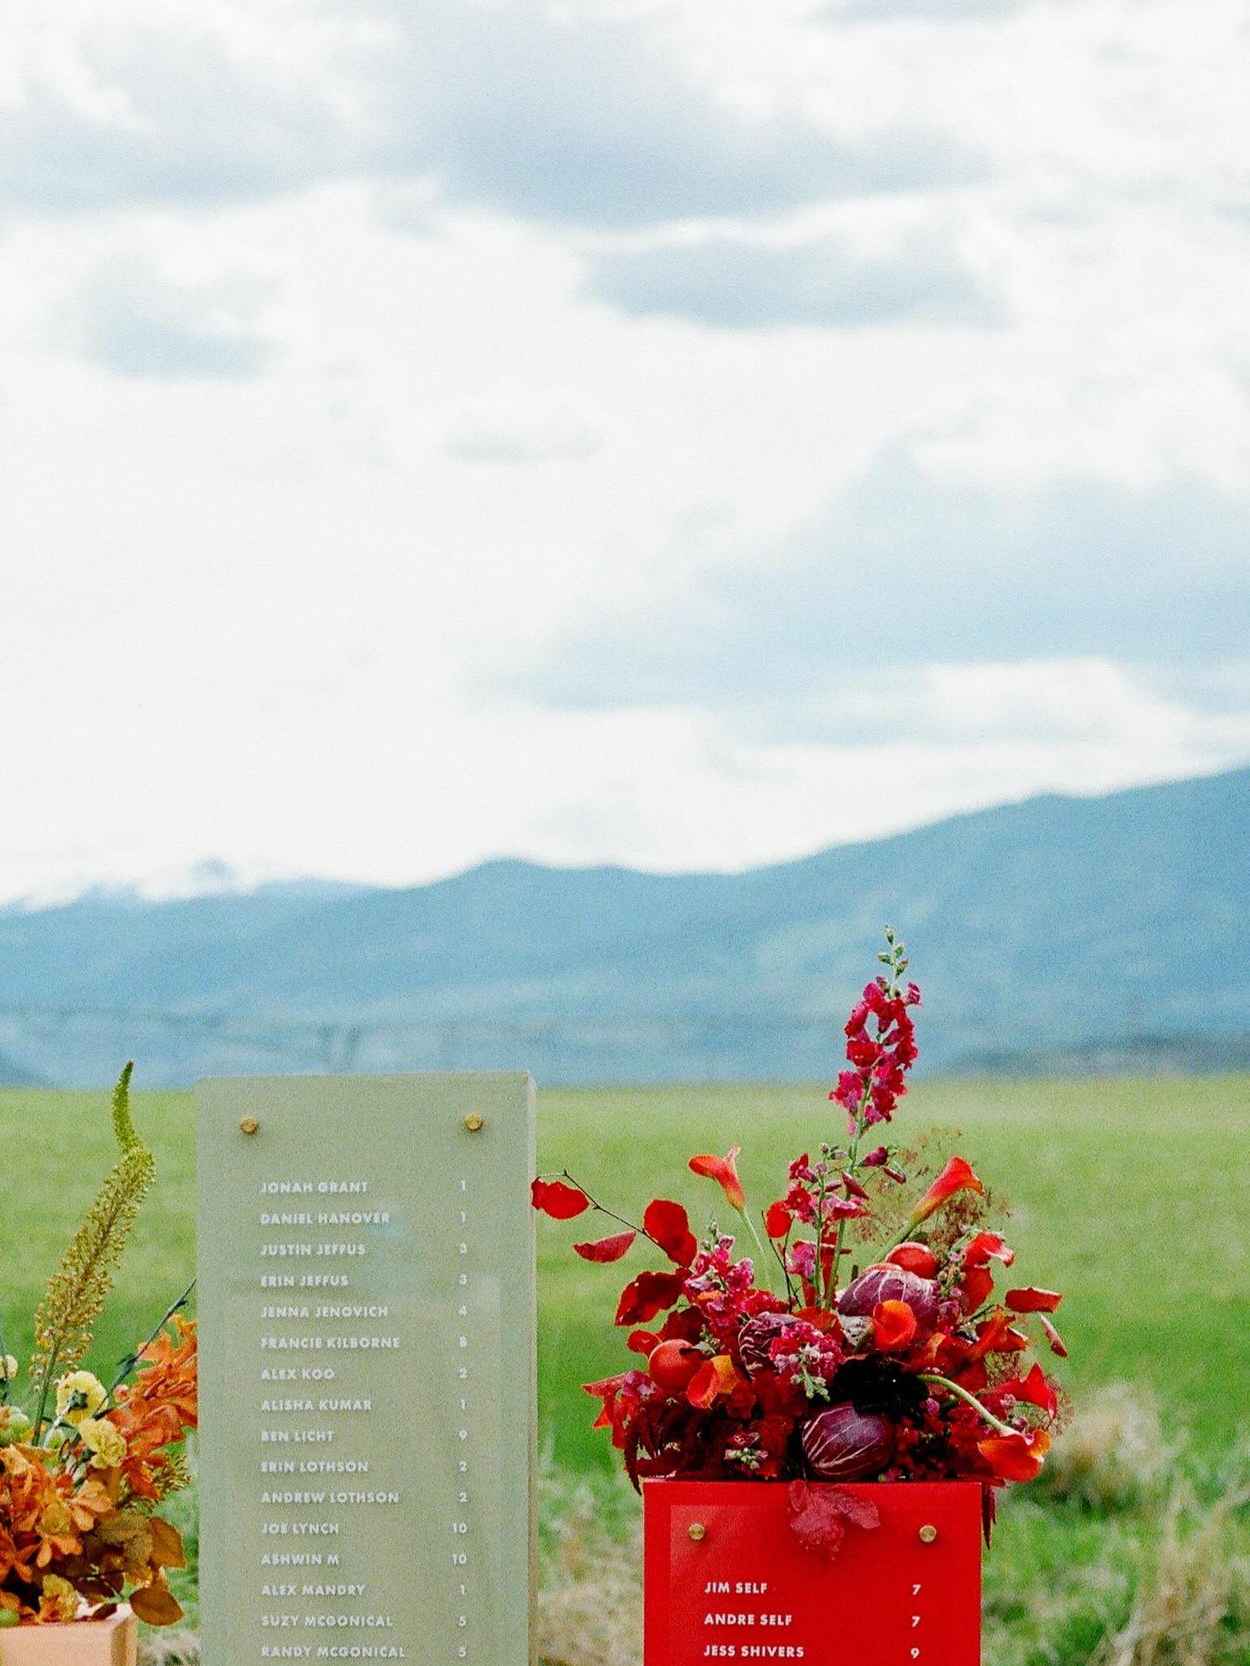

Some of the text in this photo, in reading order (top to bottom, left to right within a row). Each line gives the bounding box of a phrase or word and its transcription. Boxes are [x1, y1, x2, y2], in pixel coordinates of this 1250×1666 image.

[260, 1179, 467, 1194] JONAH GRANT 1
[259, 1211, 467, 1225] DANIEL HANOVER 1
[260, 1304, 468, 1318] JENNA JENOVICH 4
[260, 1367, 468, 1380] ALEX KOO 2
[260, 1459, 468, 1473] ERIN LOTHSON 2
[261, 1521, 468, 1535] JOE LYNCH 10
[261, 1583, 466, 1596] ALEX MANDRY 1
[704, 1581, 922, 1596] JIM SELF 7
[703, 1612, 921, 1628] ANDRE SELF 7
[703, 1644, 921, 1659] JESS SHIVERS 9
